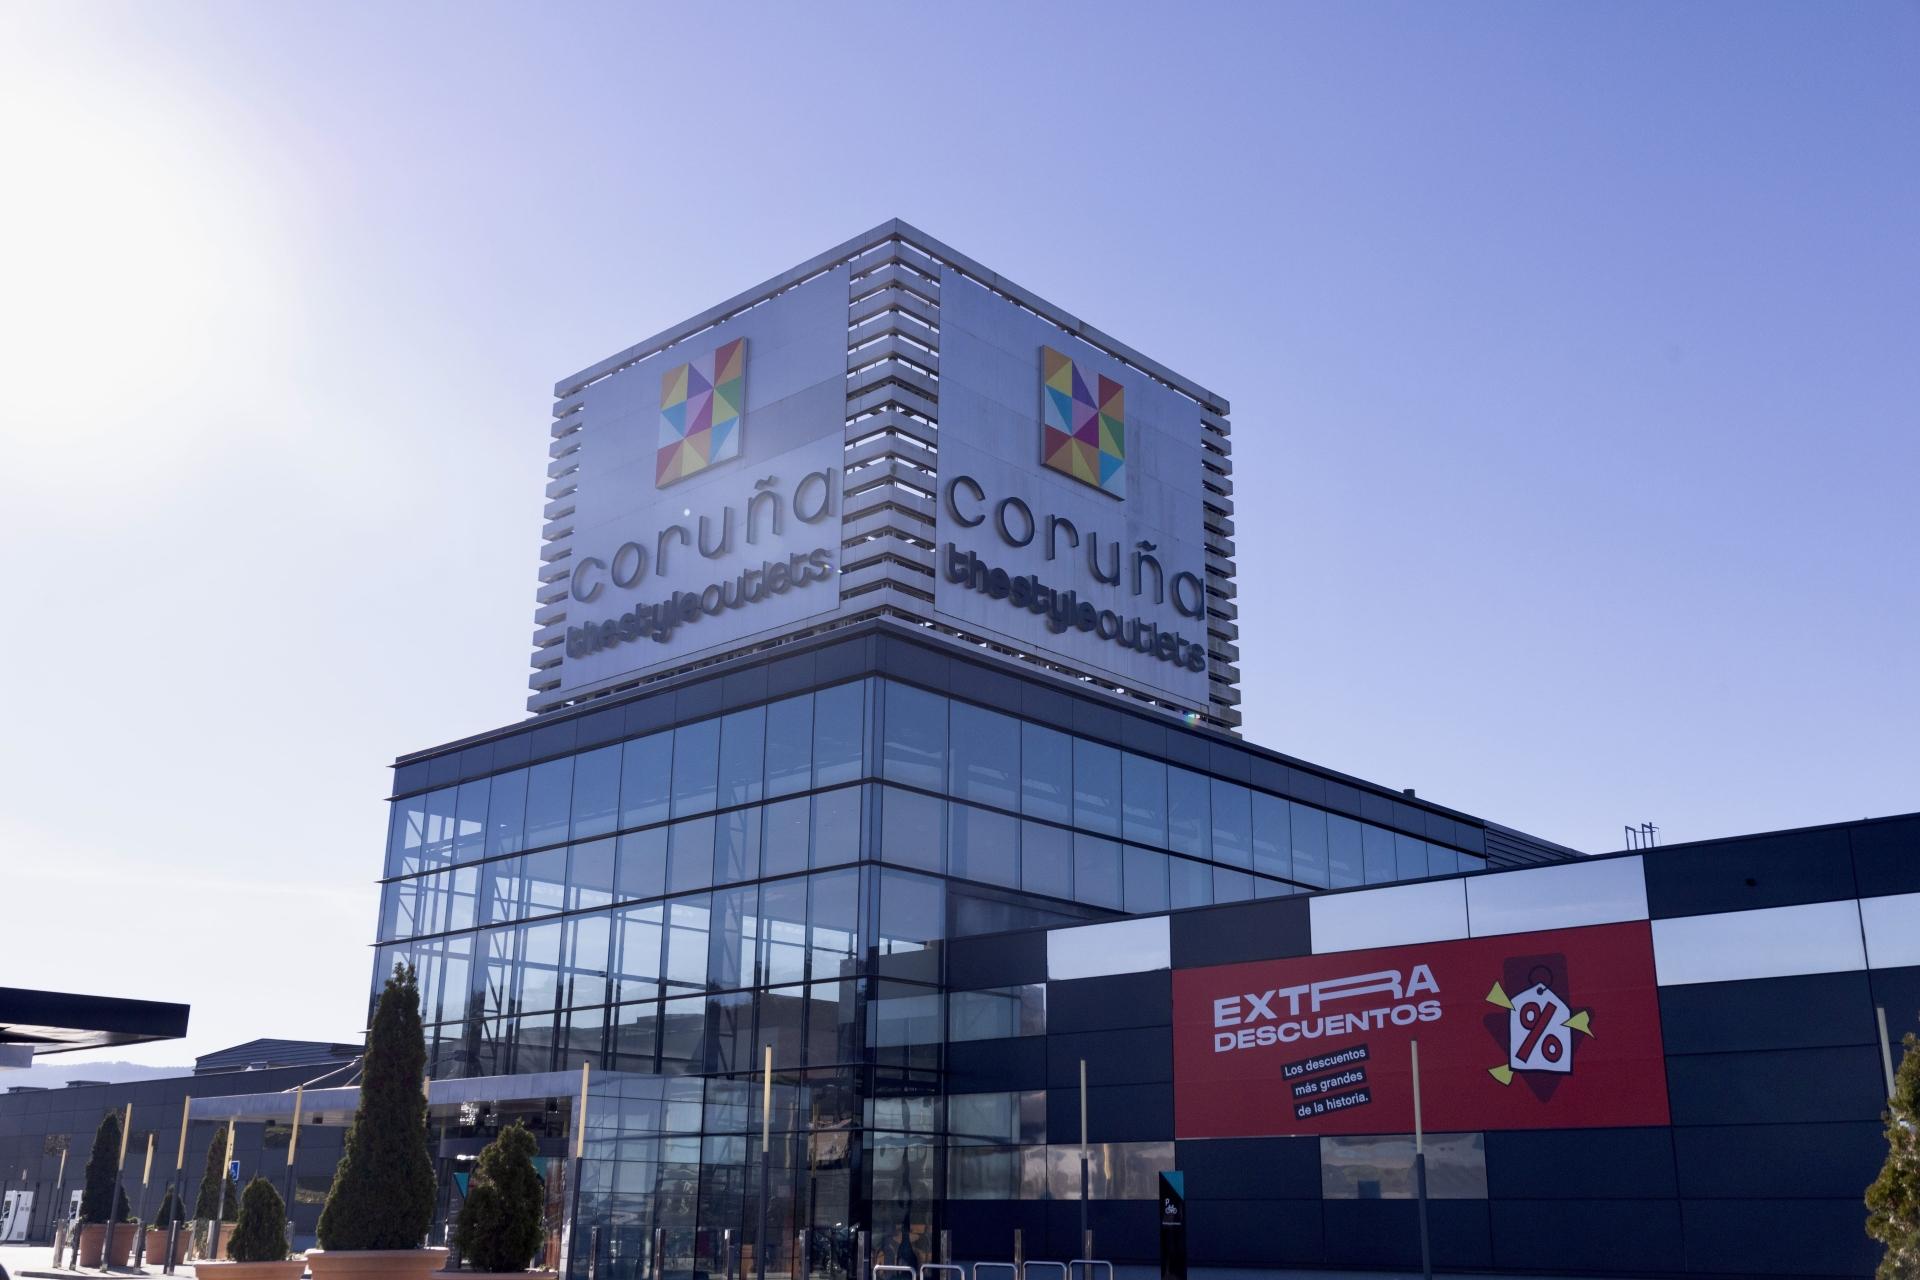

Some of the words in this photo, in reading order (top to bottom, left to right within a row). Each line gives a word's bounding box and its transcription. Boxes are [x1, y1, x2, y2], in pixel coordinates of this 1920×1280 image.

[571, 467, 835, 602] coruña
[947, 475, 1205, 621] coruña
[1213, 963, 1441, 1028] EXTRA
[1214, 1000, 1442, 1053] DESCUENTOS
[1284, 1065, 1304, 1077] Los
[1305, 1048, 1366, 1072] descuentos
[1295, 1082, 1318, 1096] más
[1320, 1071, 1363, 1093] grandes
[1298, 1105, 1312, 1117] de
[1314, 1102, 1324, 1113] la
[1326, 1092, 1369, 1110] historia.
